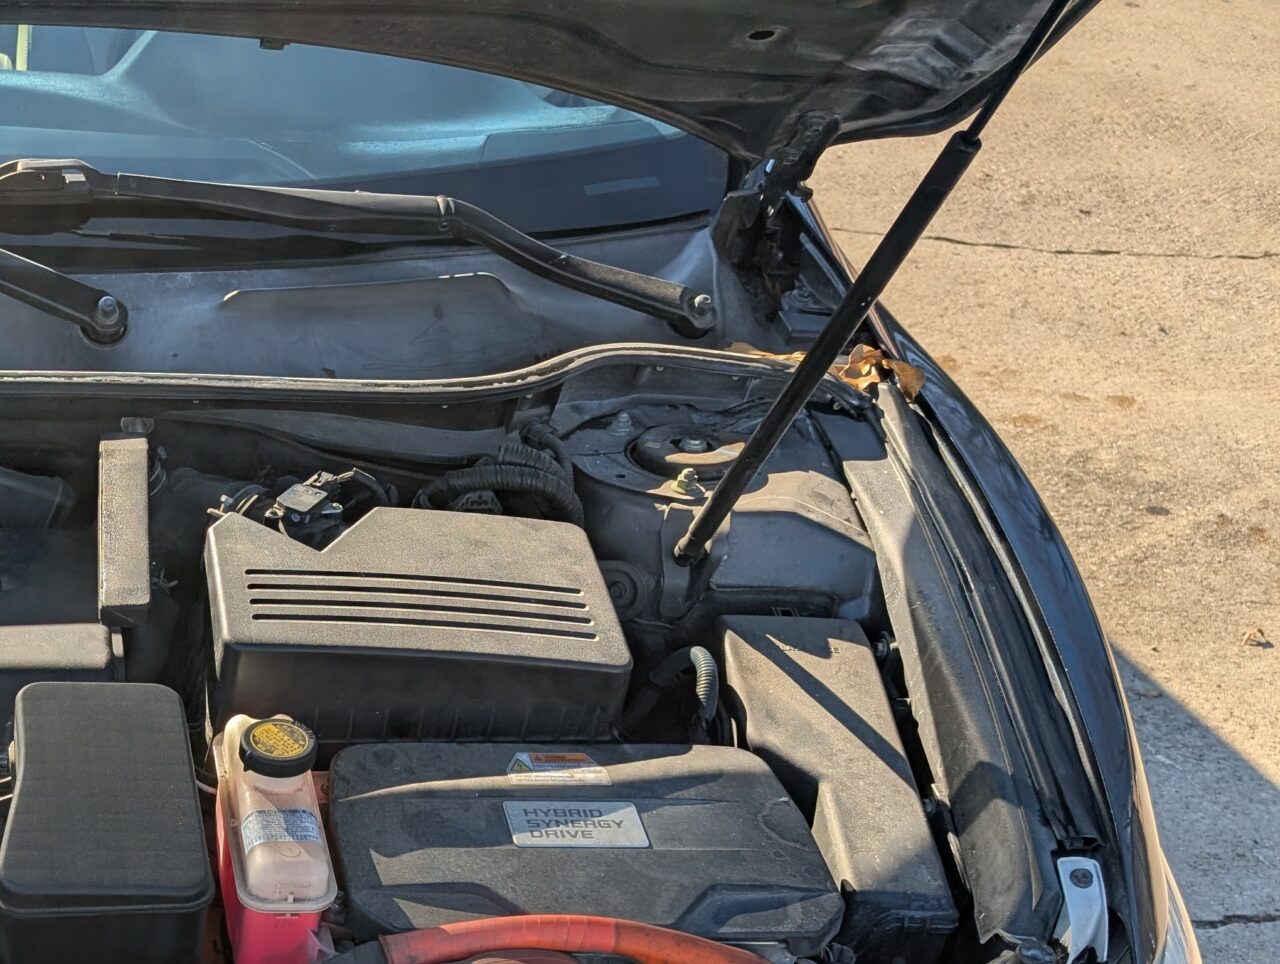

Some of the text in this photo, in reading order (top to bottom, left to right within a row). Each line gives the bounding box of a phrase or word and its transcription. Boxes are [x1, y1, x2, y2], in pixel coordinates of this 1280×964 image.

[523, 808, 603, 818] HYBRID
[527, 819, 624, 829] SYNERGY
[530, 830, 594, 839] DRIVE
